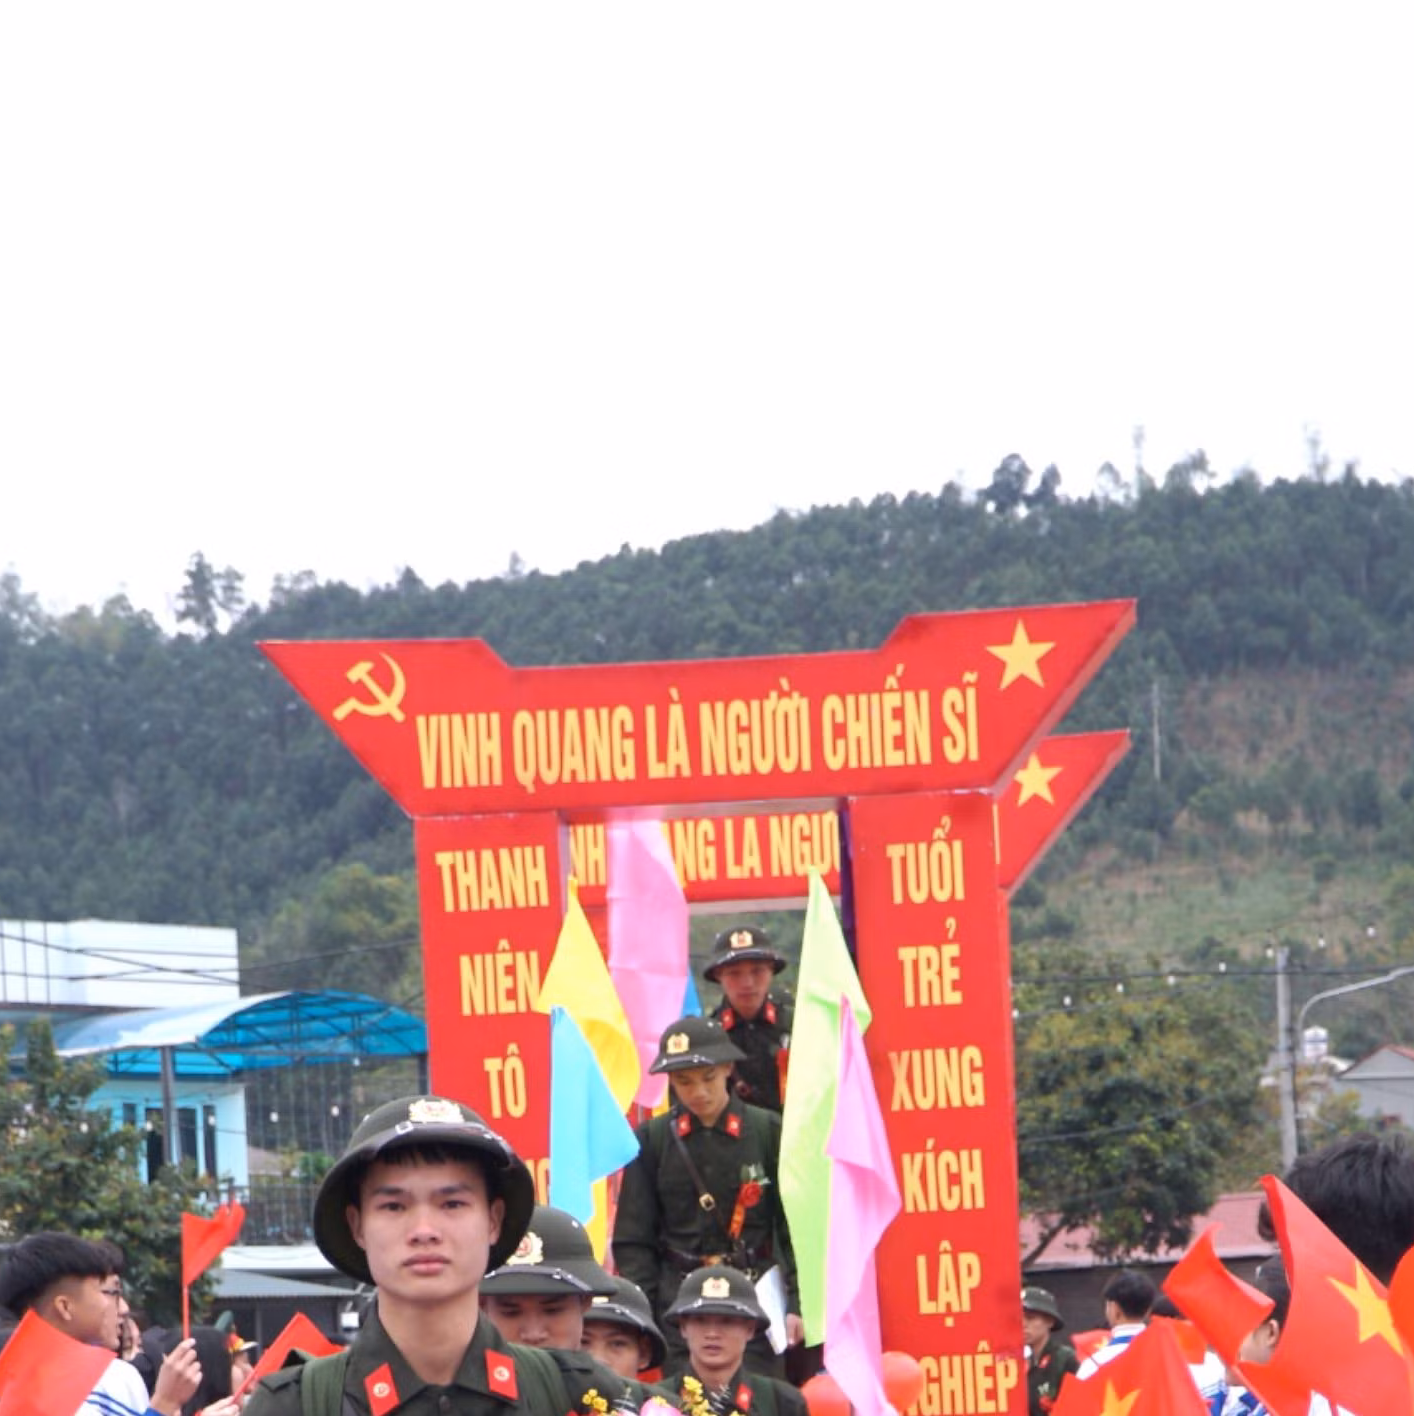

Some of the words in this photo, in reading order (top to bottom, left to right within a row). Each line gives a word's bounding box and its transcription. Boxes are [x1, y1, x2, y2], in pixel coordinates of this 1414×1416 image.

[417, 711, 502, 789] VINH
[512, 704, 636, 793] QUANG
[645, 687, 692, 779] LÀ
[699, 677, 813, 777] NGƯỜI
[821, 663, 933, 771] CHIẾN
[942, 671, 980, 764] SĨ
[434, 845, 550, 913] THANH
[886, 814, 965, 905] TUỔI
[459, 938, 540, 1017] NIÊN
[897, 916, 963, 1007] TRẺ
[483, 1042, 527, 1119] TÔ
[889, 1045, 986, 1111] XUNG
[900, 1137, 986, 1214] KÍCH
[916, 1239, 982, 1328] LẬP
